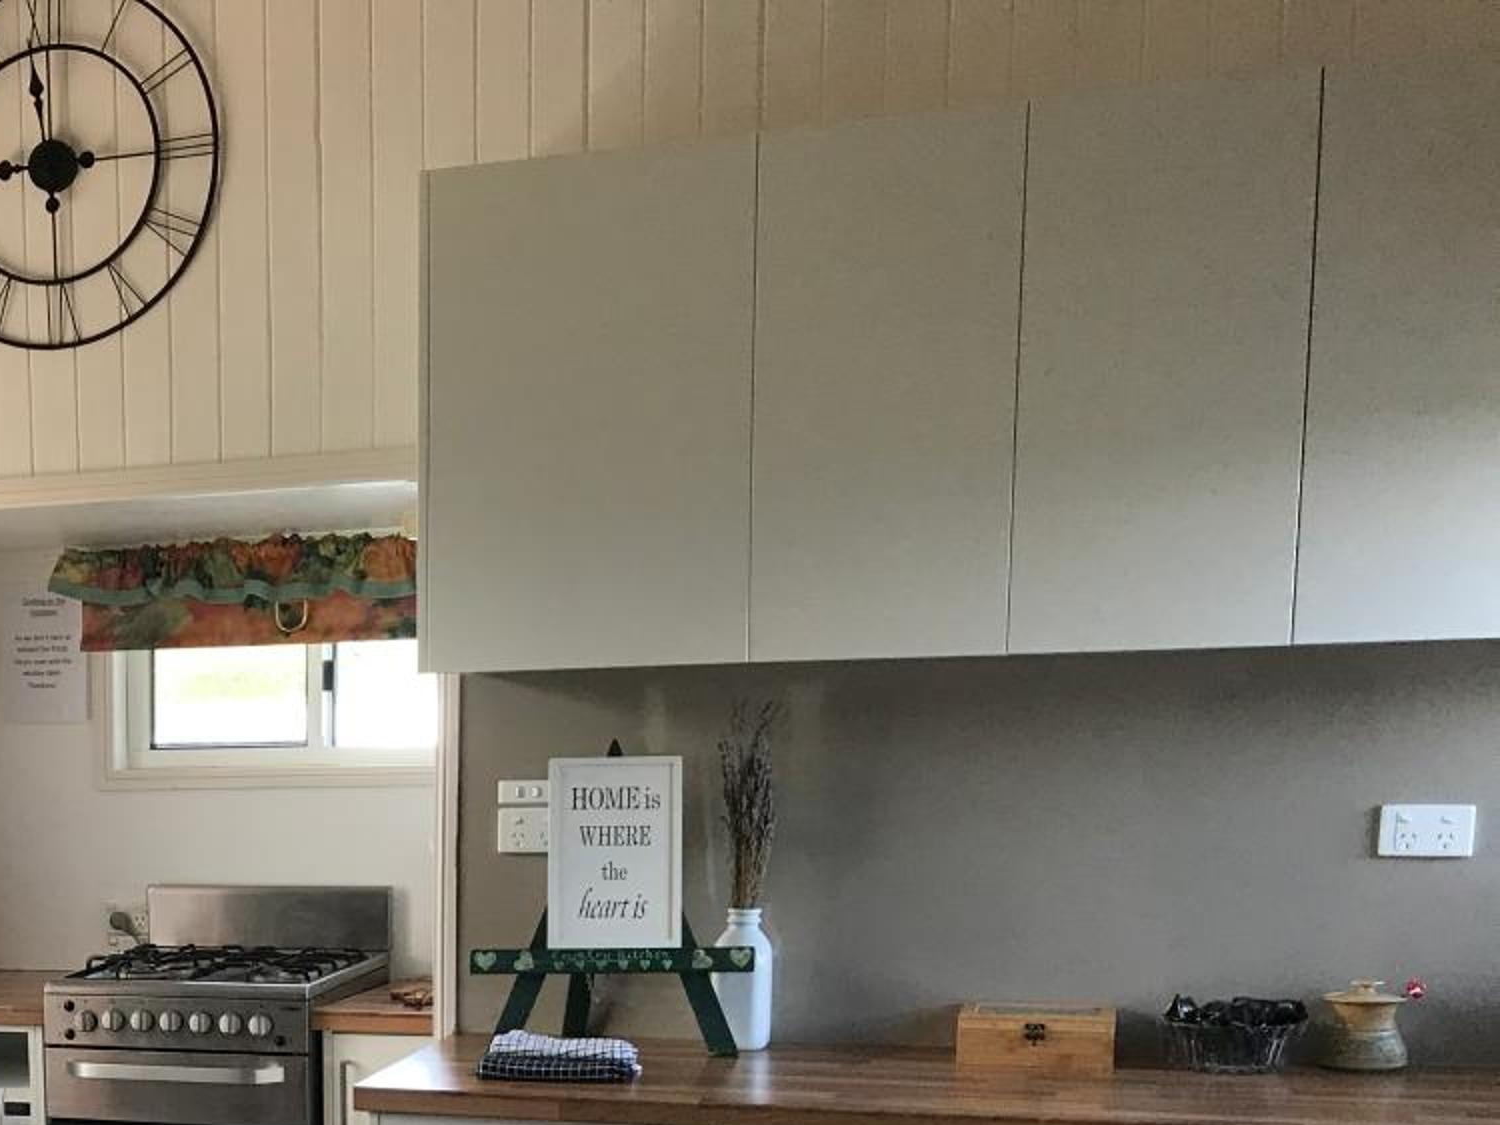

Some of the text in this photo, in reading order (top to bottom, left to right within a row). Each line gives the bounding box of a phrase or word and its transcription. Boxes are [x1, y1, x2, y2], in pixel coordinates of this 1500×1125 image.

[572, 786, 661, 811] HOME is
[579, 825, 651, 847] WHERE
[601, 861, 628, 881] the
[578, 887, 649, 920] heart is
